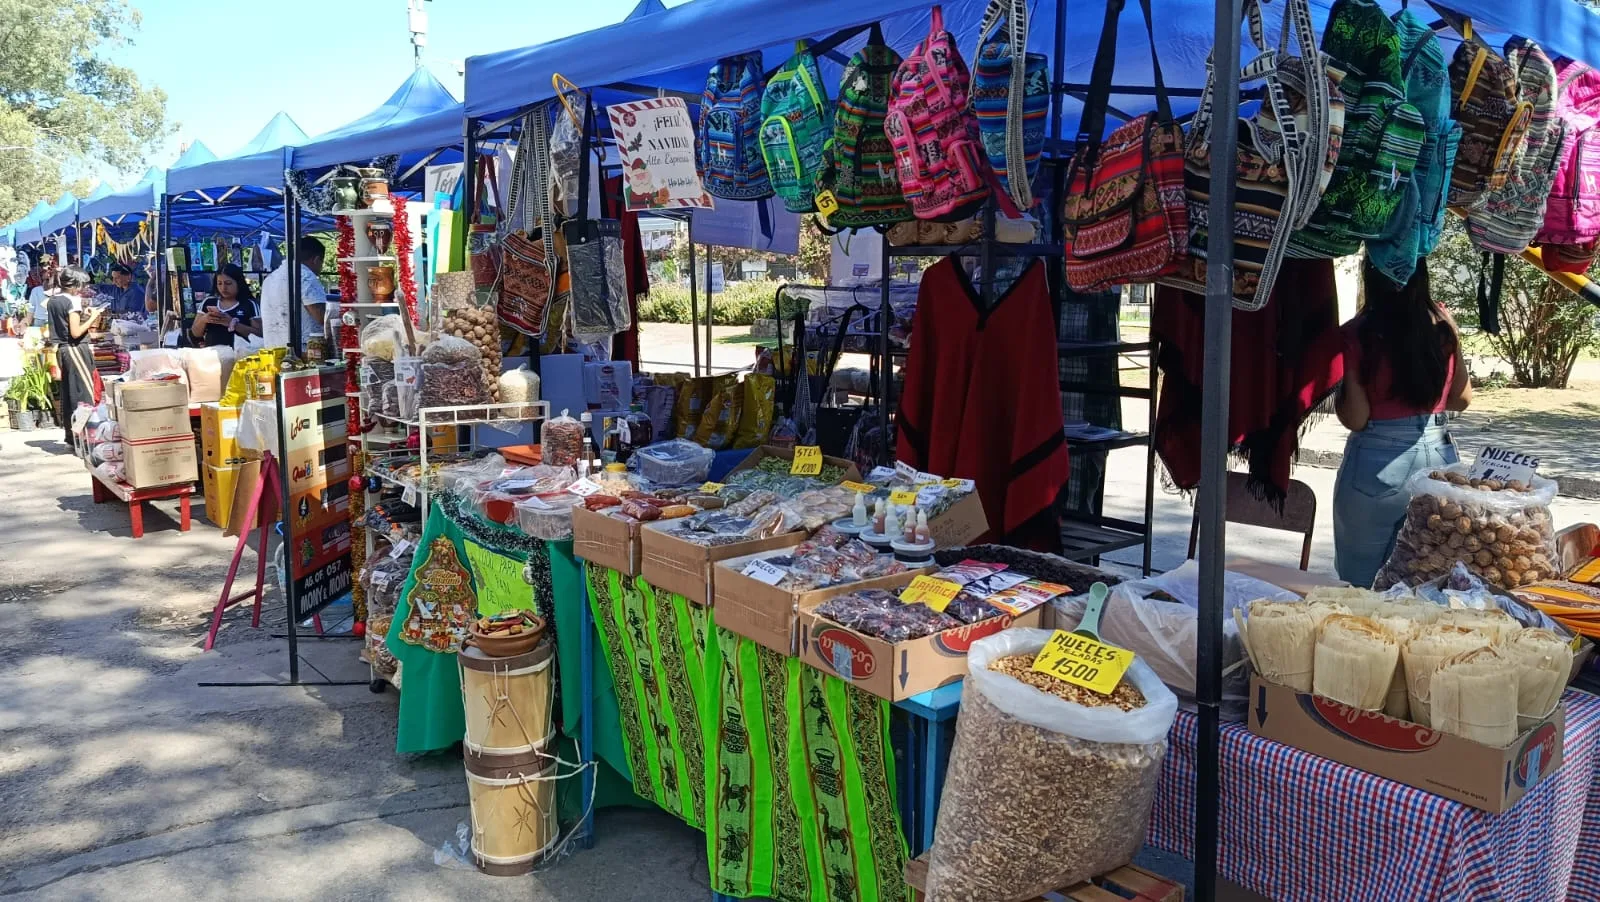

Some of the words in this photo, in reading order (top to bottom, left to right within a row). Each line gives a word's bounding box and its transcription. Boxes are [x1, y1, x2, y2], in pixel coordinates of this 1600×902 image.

[1481, 446, 1540, 468] NUECES
[909, 581, 957, 599] JAMAICA
[1053, 633, 1117, 661] NUECES
[1056, 646, 1103, 665] PELADAS
[1051, 657, 1098, 682] 1500
